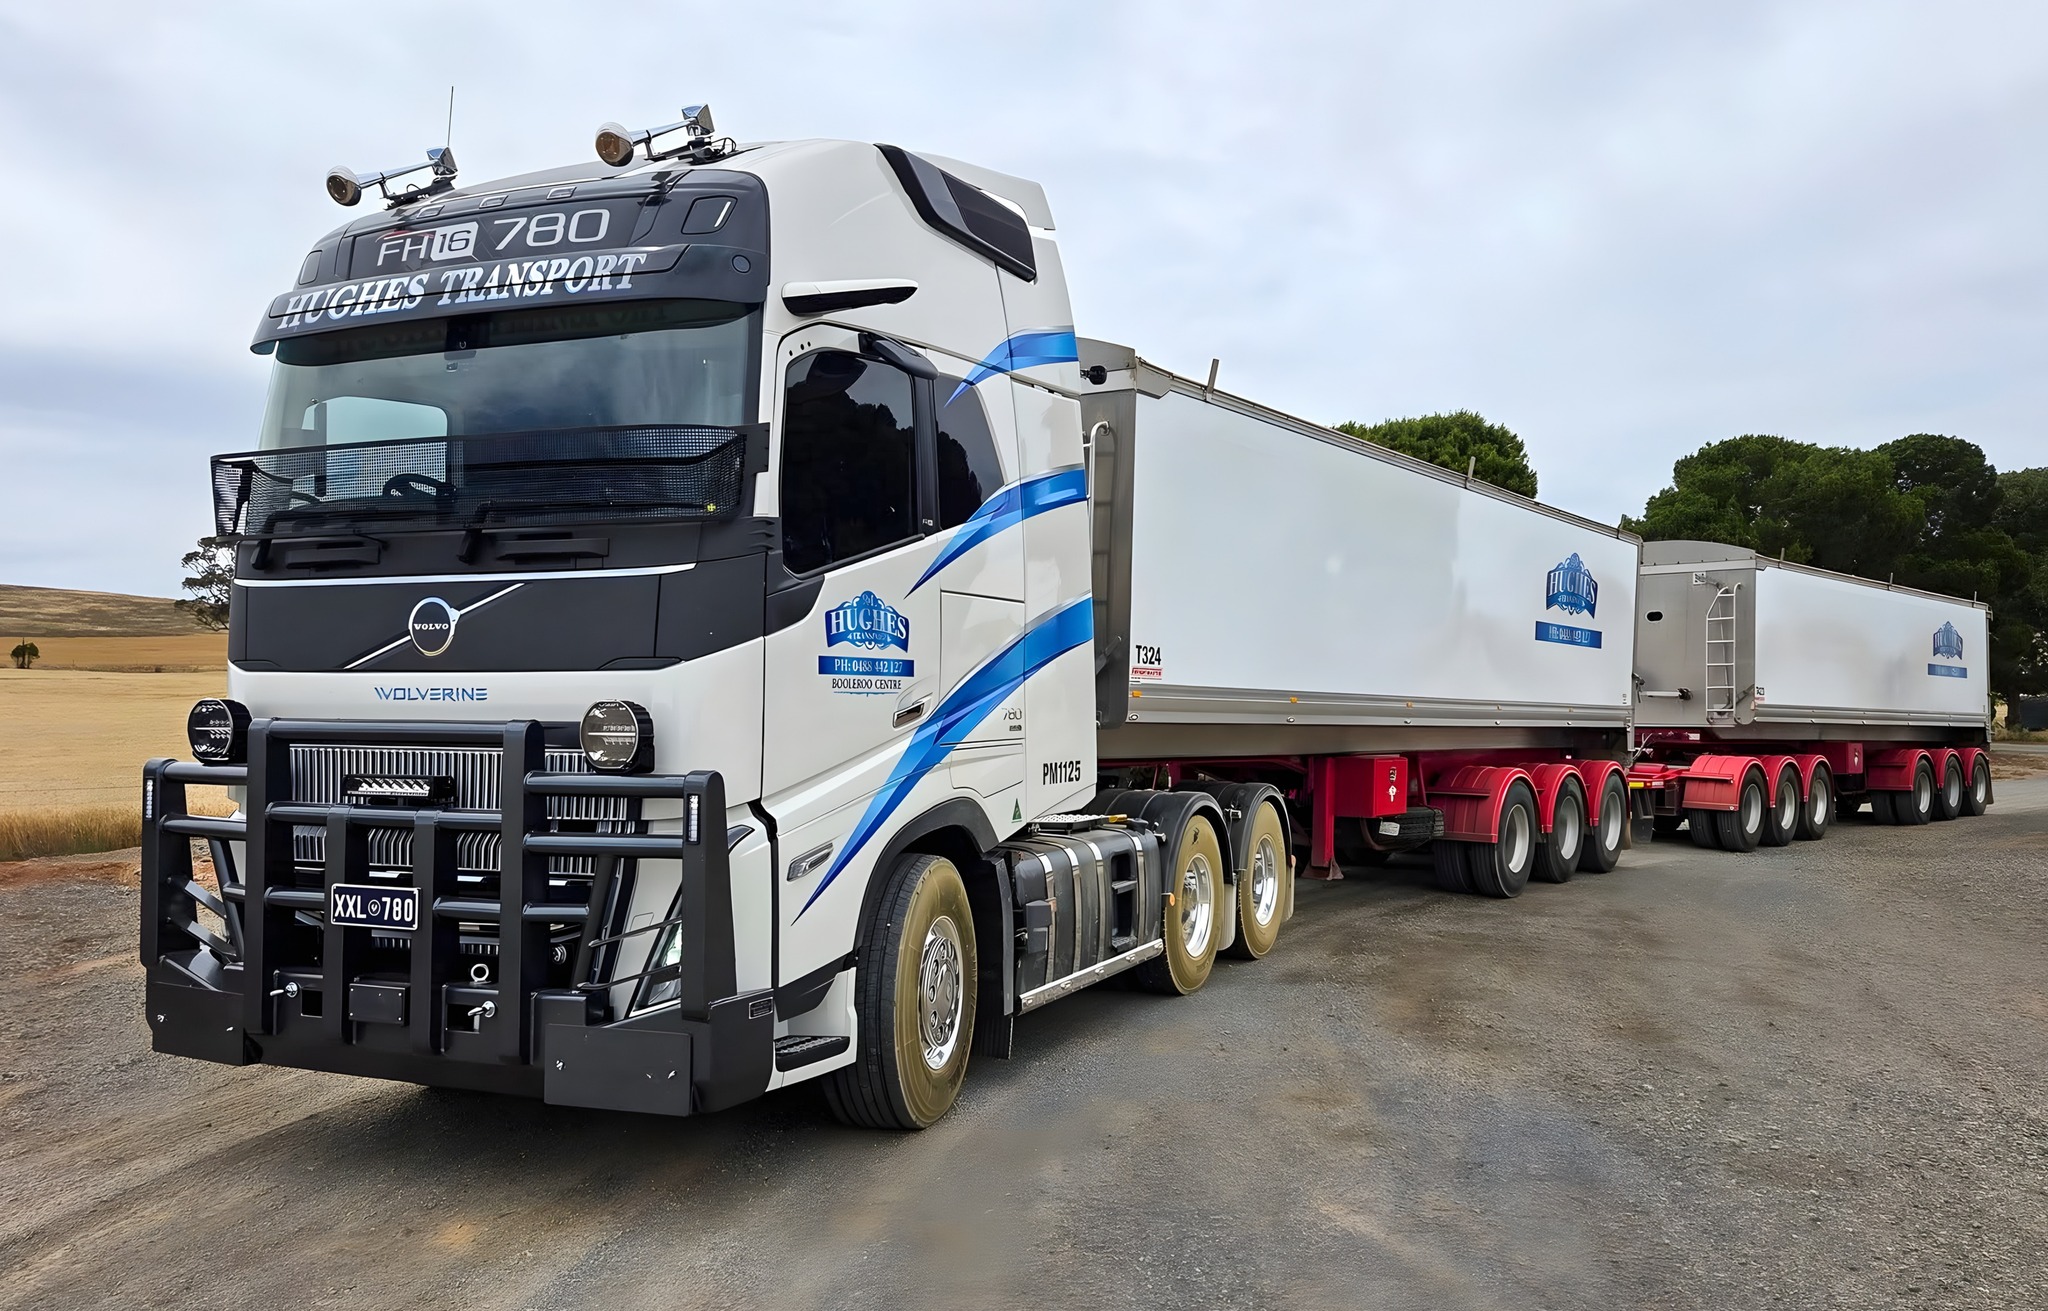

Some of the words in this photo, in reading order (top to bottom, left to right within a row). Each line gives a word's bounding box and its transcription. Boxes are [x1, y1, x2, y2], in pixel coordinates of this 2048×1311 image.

[493, 208, 610, 251] 780
[277, 272, 430, 331] HUGHES
[436, 253, 648, 307] TRANSPORT
[829, 607, 907, 640] HUGHES
[834, 658, 851, 672] PH:
[874, 660, 889, 673] 442
[890, 661, 903, 674] 127
[1135, 644, 1162, 666] T324
[374, 686, 488, 702] WOLVERINE
[832, 678, 873, 690] BOOLEROO
[874, 678, 902, 690] CENTRE
[1042, 760, 1081, 786] PM1125
[334, 893, 367, 919] XXL
[381, 896, 413, 922] 780
